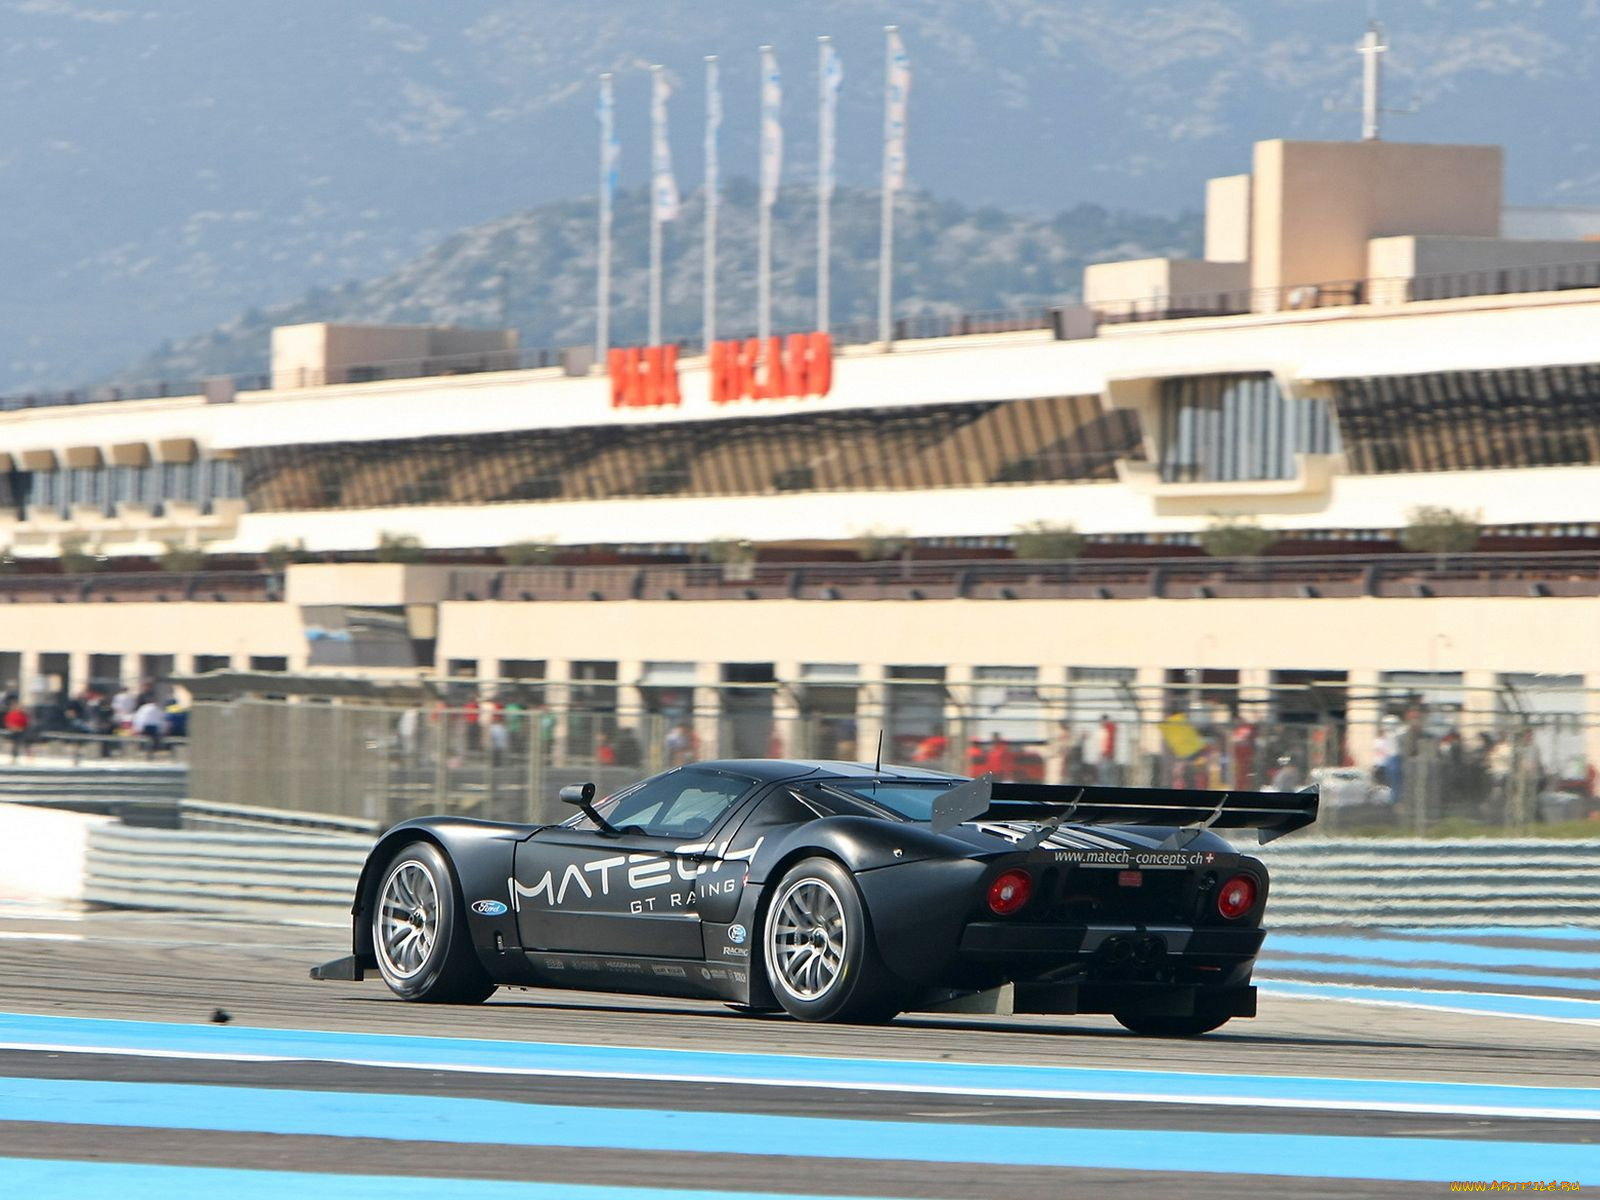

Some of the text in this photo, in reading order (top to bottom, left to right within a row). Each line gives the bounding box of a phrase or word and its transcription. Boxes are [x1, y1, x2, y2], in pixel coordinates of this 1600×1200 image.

[508, 836, 764, 912] MATECH
[1054, 851, 1203, 866] www.matech-concepts.ch
[630, 879, 735, 914] GT RAING
